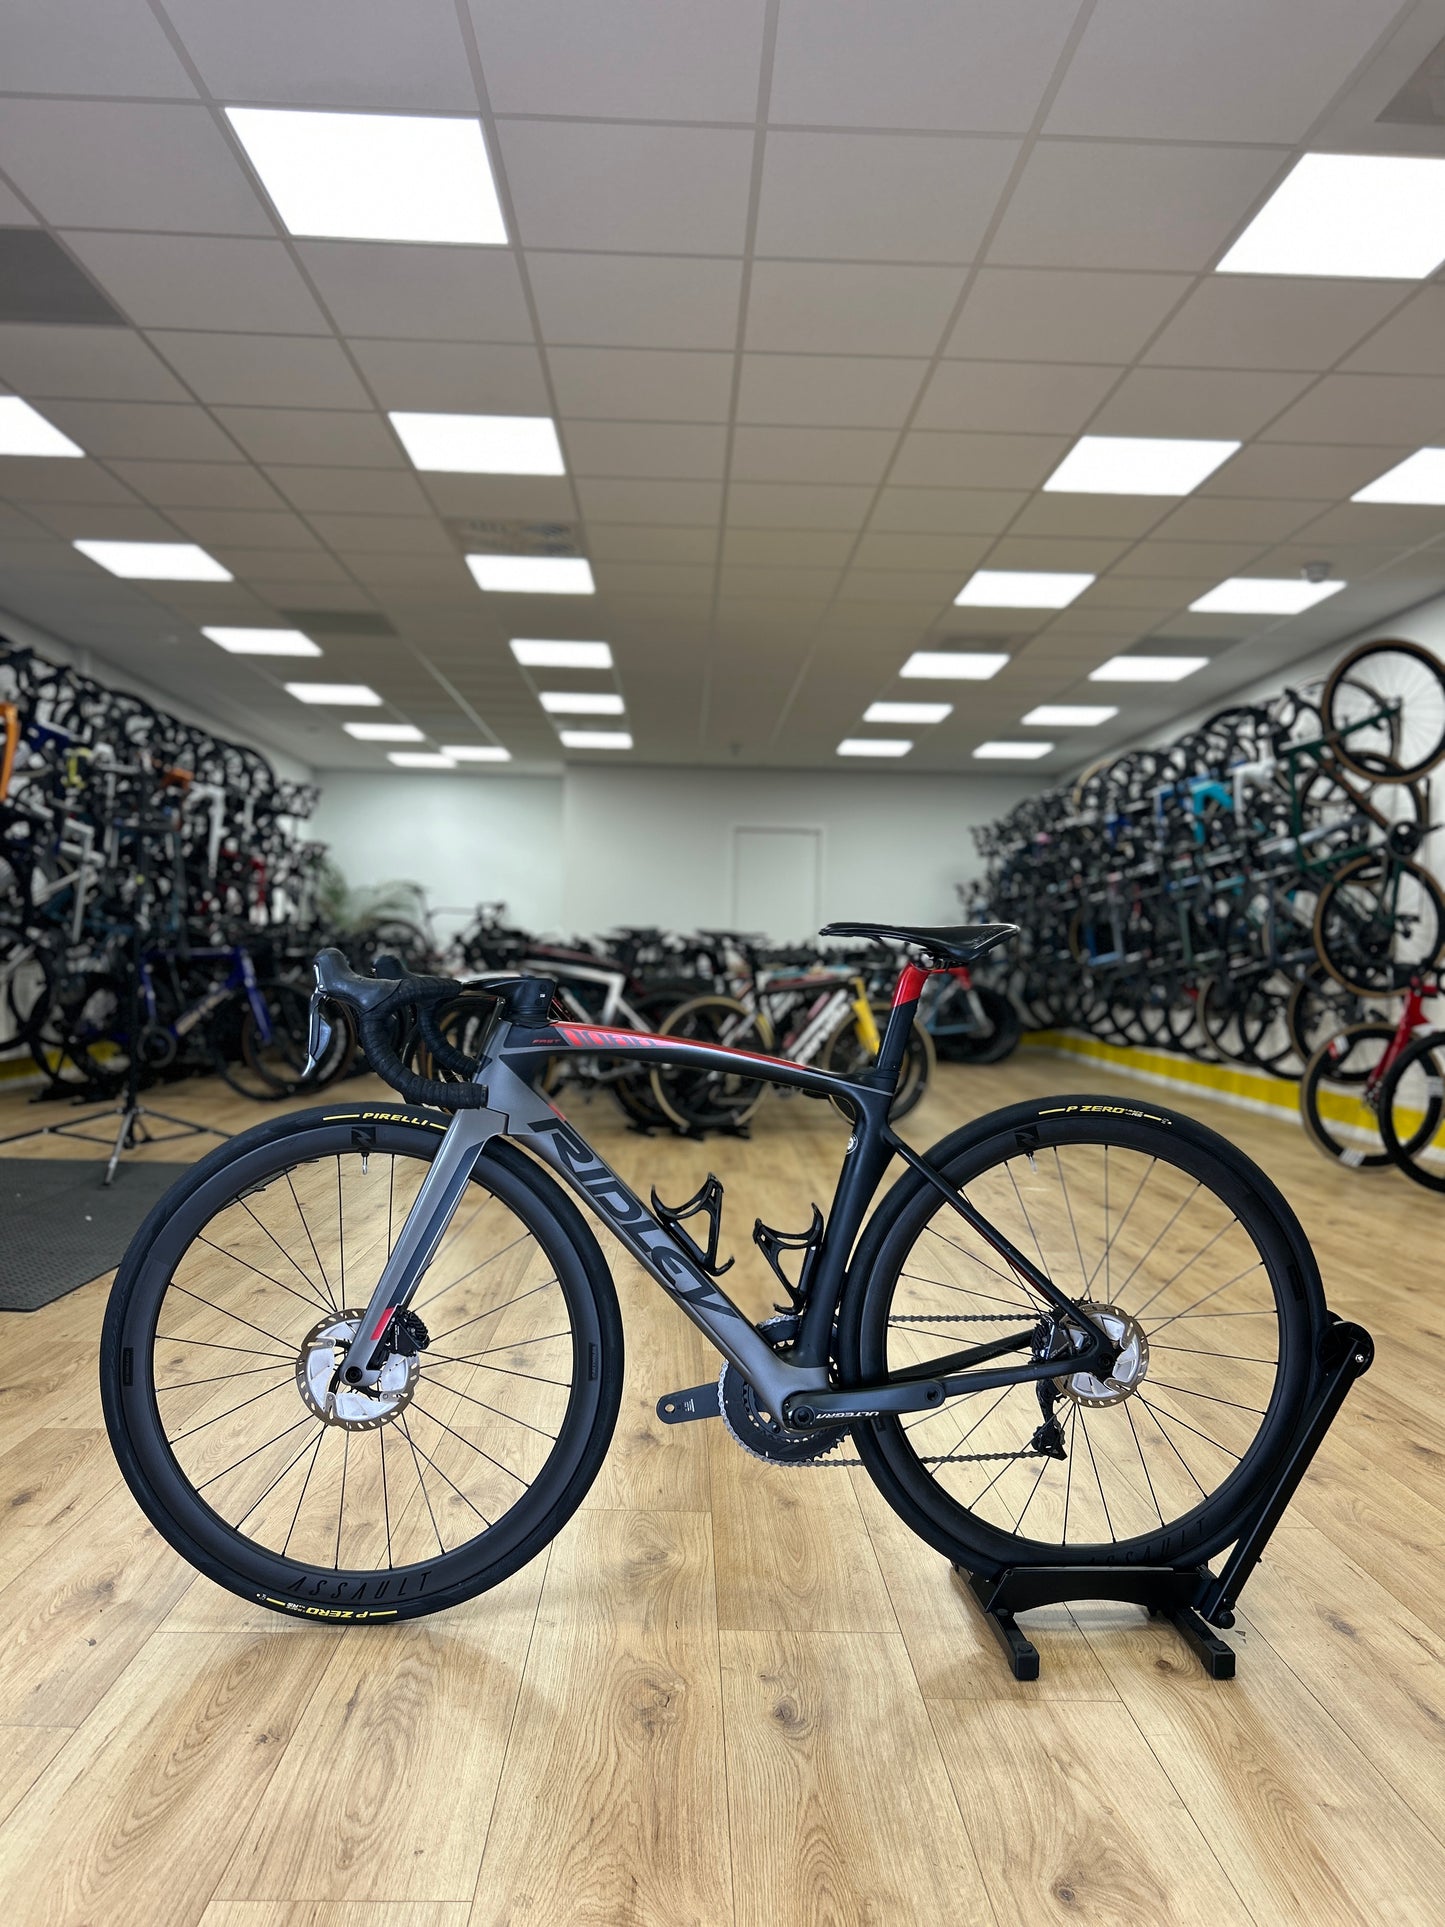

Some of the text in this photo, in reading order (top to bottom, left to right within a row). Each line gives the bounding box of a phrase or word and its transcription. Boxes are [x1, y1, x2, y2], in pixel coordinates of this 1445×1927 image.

[1080, 1105, 1125, 1114] ZERO
[362, 1112, 428, 1126] PIRELLI
[527, 1117, 740, 1319] RIDLEY
[816, 1411, 879, 1419] ULTEGRA
[287, 1571, 432, 1600] ASSAULT
[305, 1607, 352, 1618] ZERO
